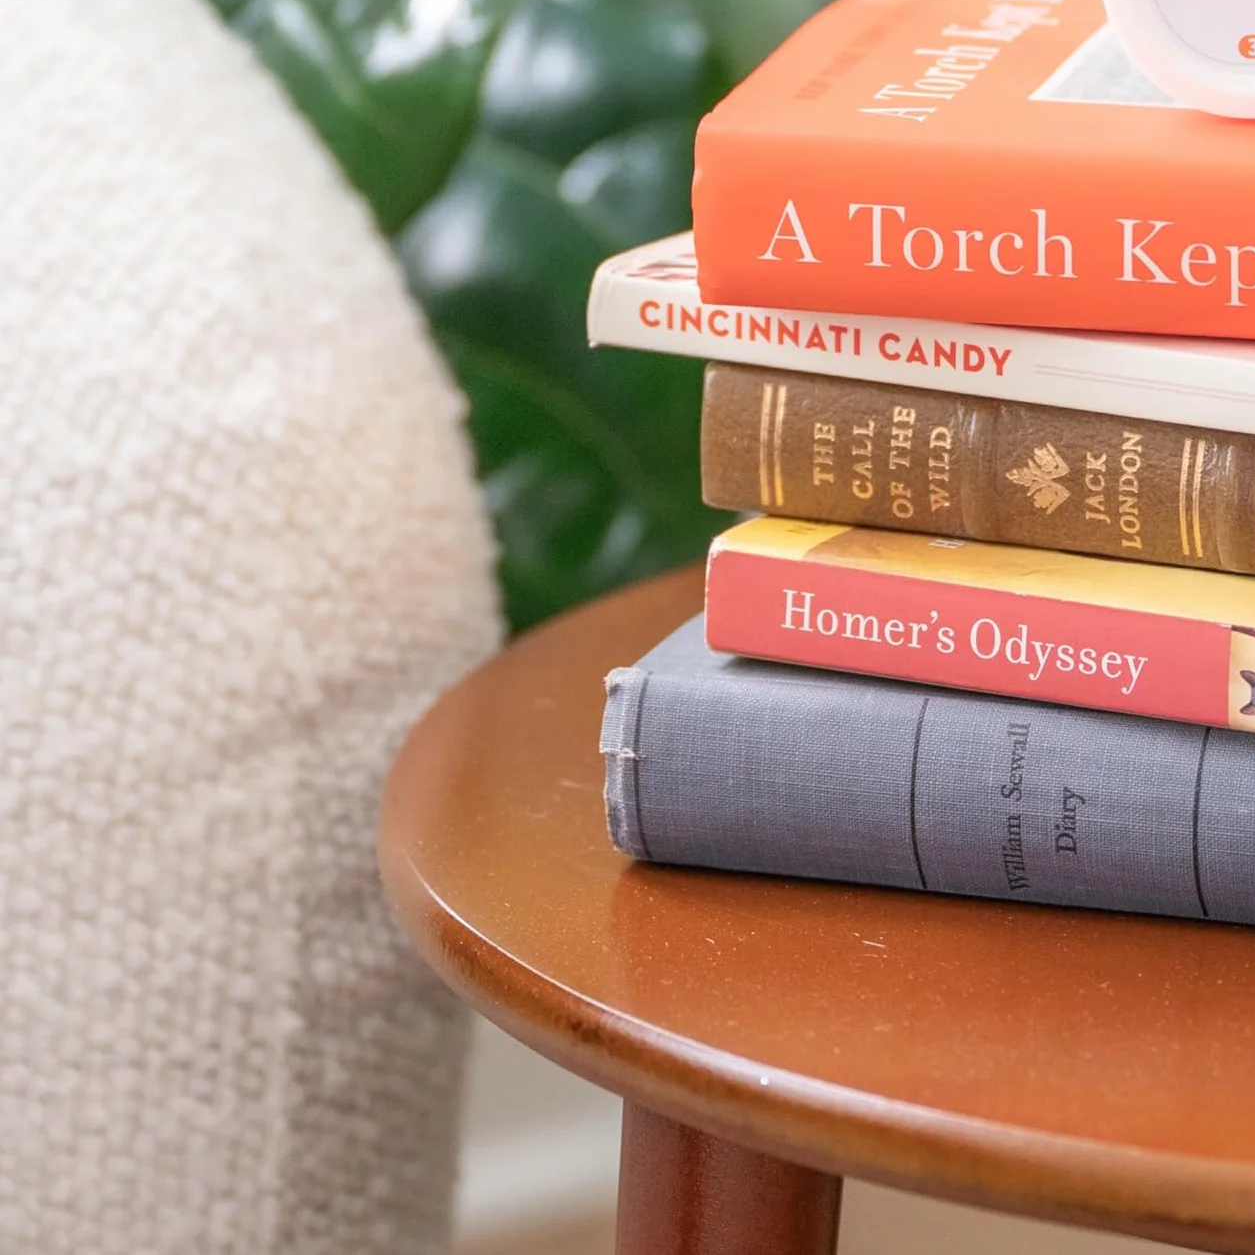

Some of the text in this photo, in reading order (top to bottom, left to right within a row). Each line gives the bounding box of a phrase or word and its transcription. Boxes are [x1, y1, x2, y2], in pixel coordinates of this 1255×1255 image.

[872, 44, 1000, 101] Torch
[757, 199, 822, 264] A
[847, 202, 1079, 279] Torch
[639, 300, 1013, 377] CINCINNATI CANDY
[812, 422, 836, 486] THE
[851, 419, 875, 500] CALL
[888, 405, 917, 519] OF THE
[927, 425, 953, 513] WILD
[1084, 451, 1112, 524] JACK
[1120, 431, 1145, 550] LONDON
[780, 589, 1149, 695] Homer’s Odyssey
[1000, 721, 1033, 893] William Sewall
[1054, 786, 1088, 856] Diary
